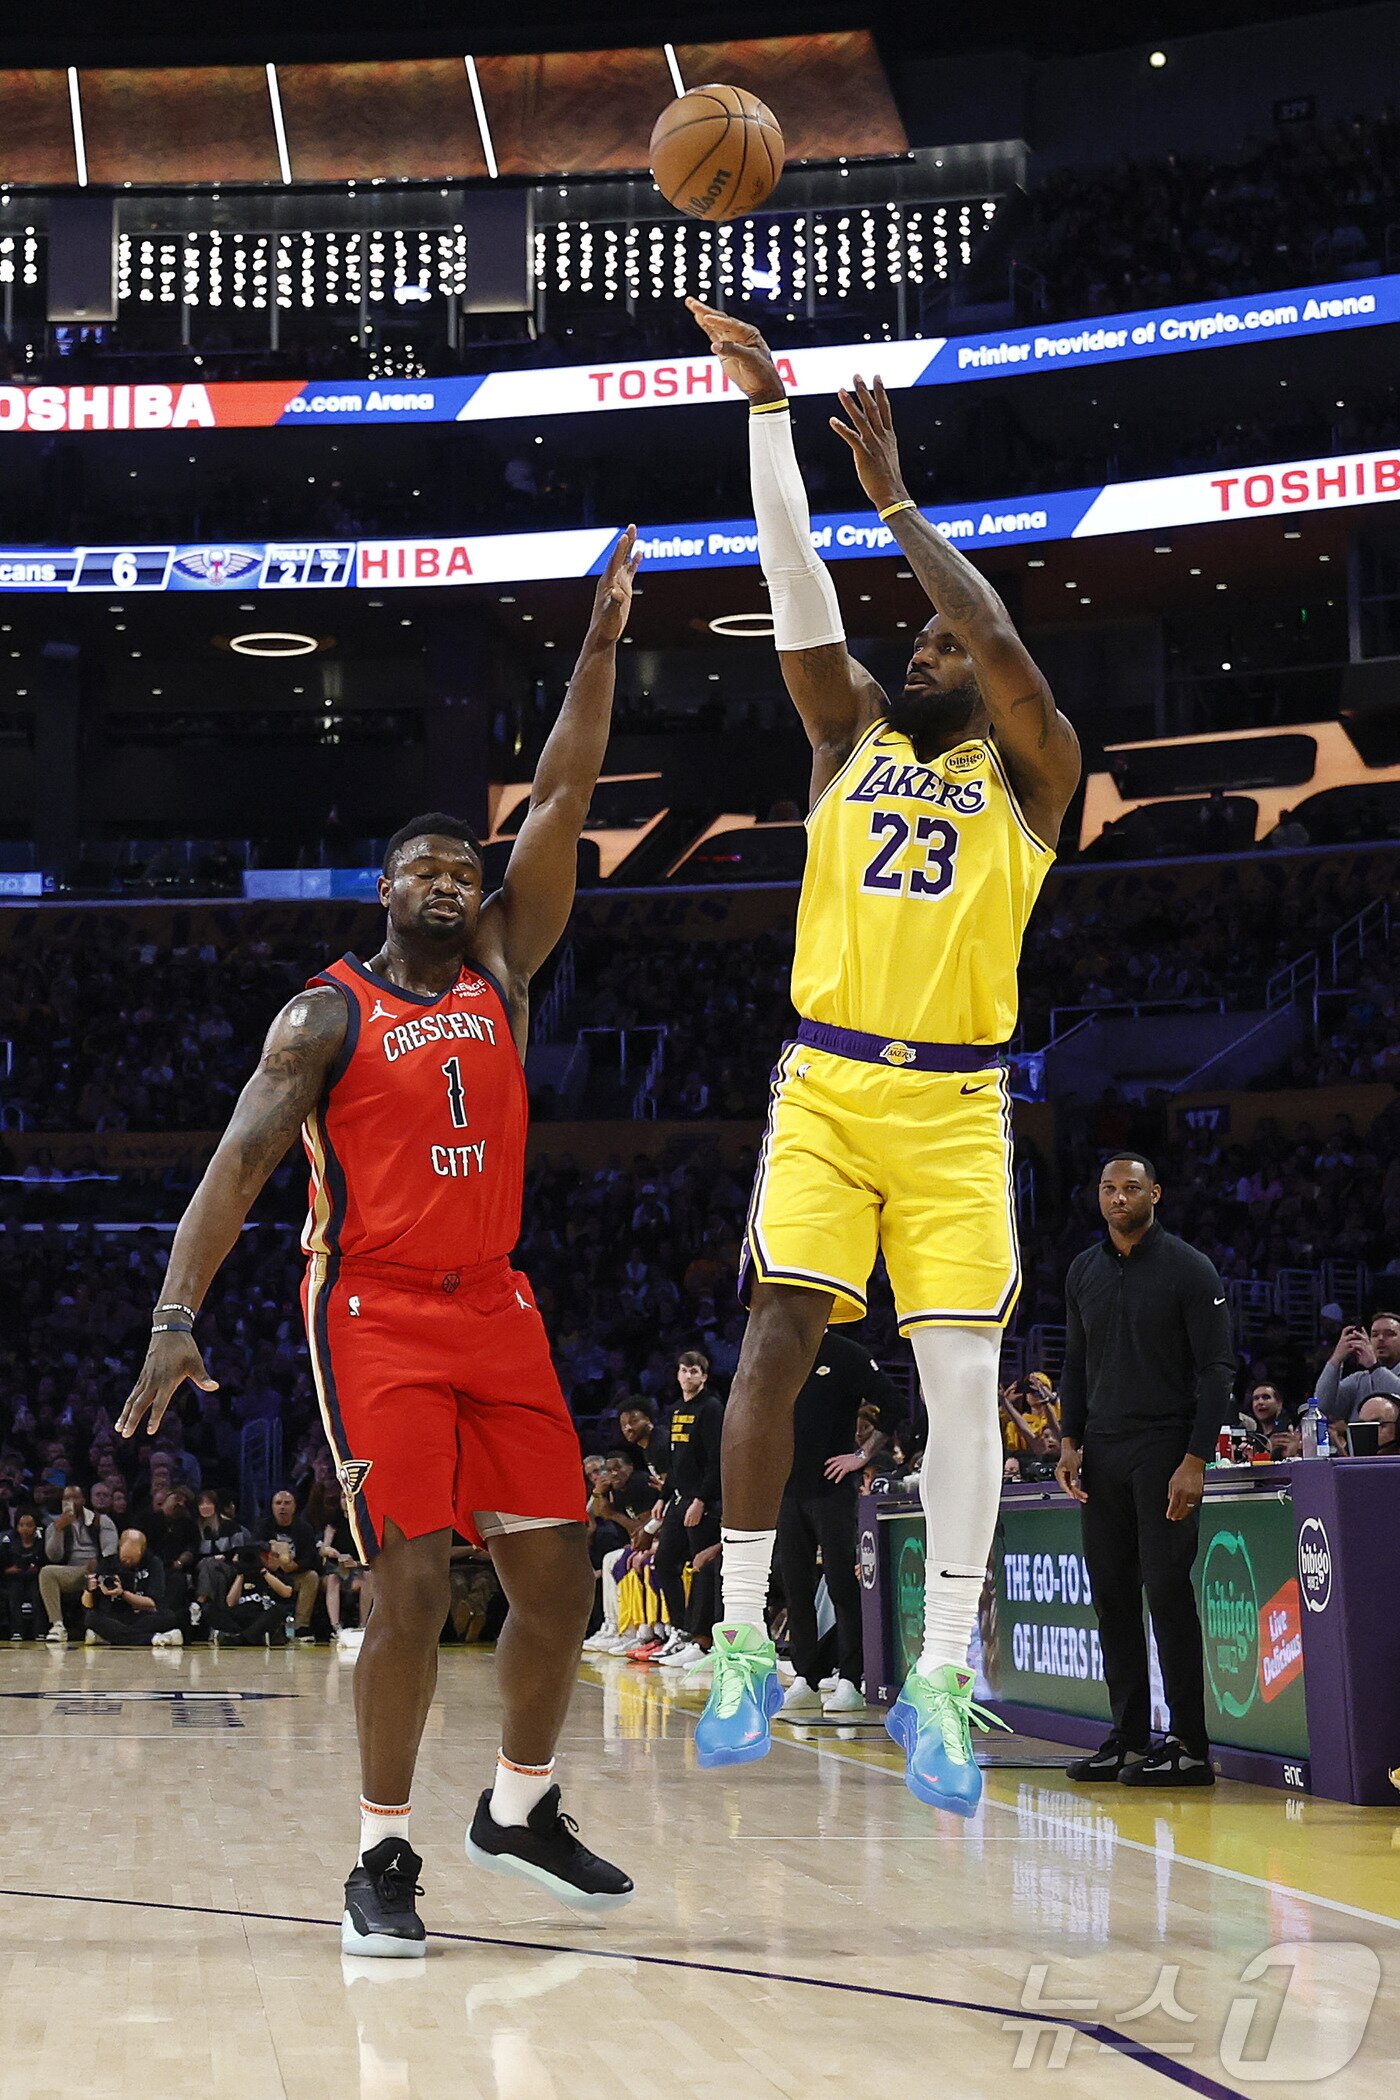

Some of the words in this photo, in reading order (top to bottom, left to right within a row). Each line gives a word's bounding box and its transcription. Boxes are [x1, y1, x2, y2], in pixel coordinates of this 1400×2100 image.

[958, 342, 1031, 369] Printer
[1034, 328, 1128, 359] Provider
[1131, 321, 1156, 345] of
[1160, 306, 1298, 341] Crypto.com
[1303, 294, 1376, 321] Arena
[284, 394, 362, 413] o.com
[365, 391, 435, 412] Arena
[589, 358, 798, 401] TOSHIA
[0, 384, 216, 431] OSHIBA
[1211, 459, 1400, 511] TOSHIB
[630, 537, 704, 560] Printer
[708, 533, 758, 555] Prov
[809, 526, 833, 548] of
[978, 510, 1047, 536] Arena
[112, 553, 138, 587] 6
[280, 561, 297, 584] 2
[321, 561, 339, 583] 7
[362, 547, 473, 579] HIBA
[949, 753, 983, 766] bibigo
[845, 755, 986, 815] LAKERS
[860, 810, 960, 902] 23
[383, 1011, 496, 1062] CRESCENT
[441, 1056, 468, 1128] 1
[430, 1139, 486, 1177] CITY
[1004, 1554, 1031, 1602] THE
[1033, 1554, 1080, 1605] GO-TO
[1301, 1543, 1328, 1584] bibigo
[1206, 1580, 1256, 1661] bibigo
[1268, 1610, 1288, 1642] Live
[1013, 1622, 1031, 1672] OF
[1033, 1625, 1089, 1680] LAKERS
